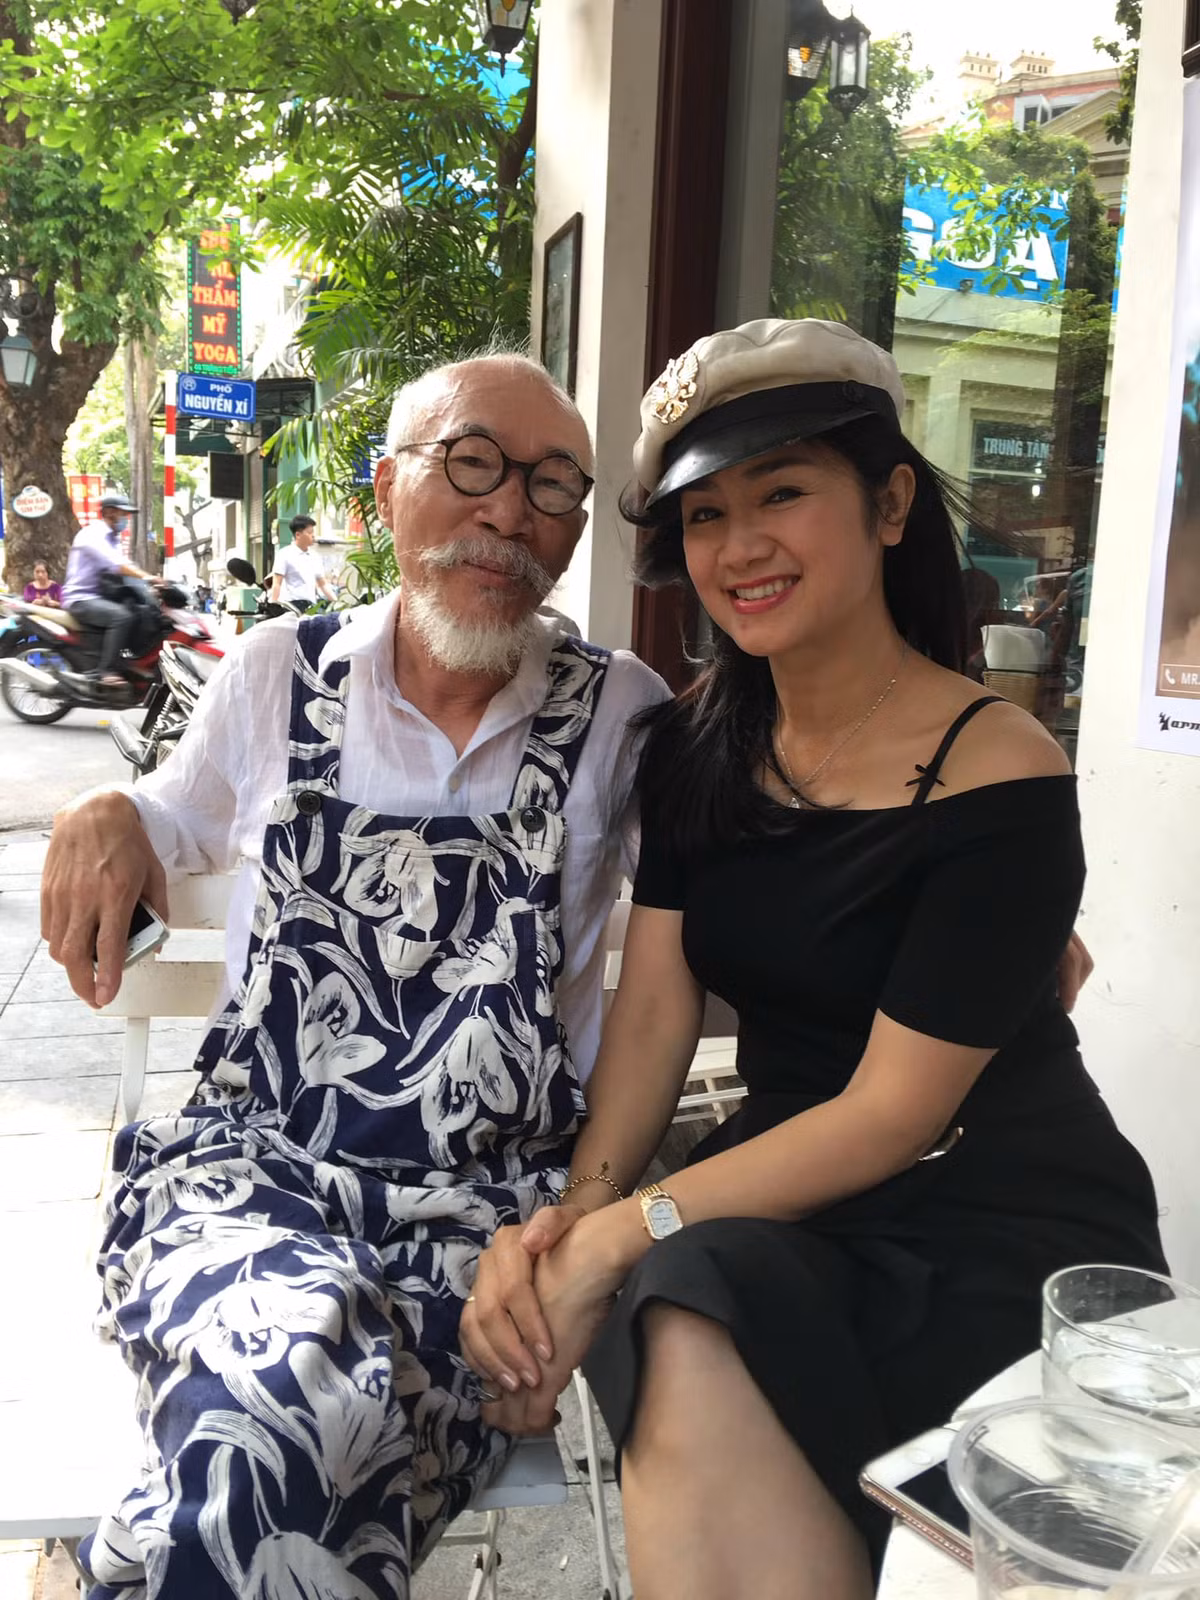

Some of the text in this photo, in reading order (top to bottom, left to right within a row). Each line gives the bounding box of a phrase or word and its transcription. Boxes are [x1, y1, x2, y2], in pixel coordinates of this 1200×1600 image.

[193, 279, 238, 308] THẨM
[202, 312, 227, 334] MỸ
[193, 341, 238, 364] YOGA
[209, 383, 233, 394] PHỐ
[185, 393, 248, 415] NGUYỄN XÍ
[983, 437, 1023, 456] TRUNG
